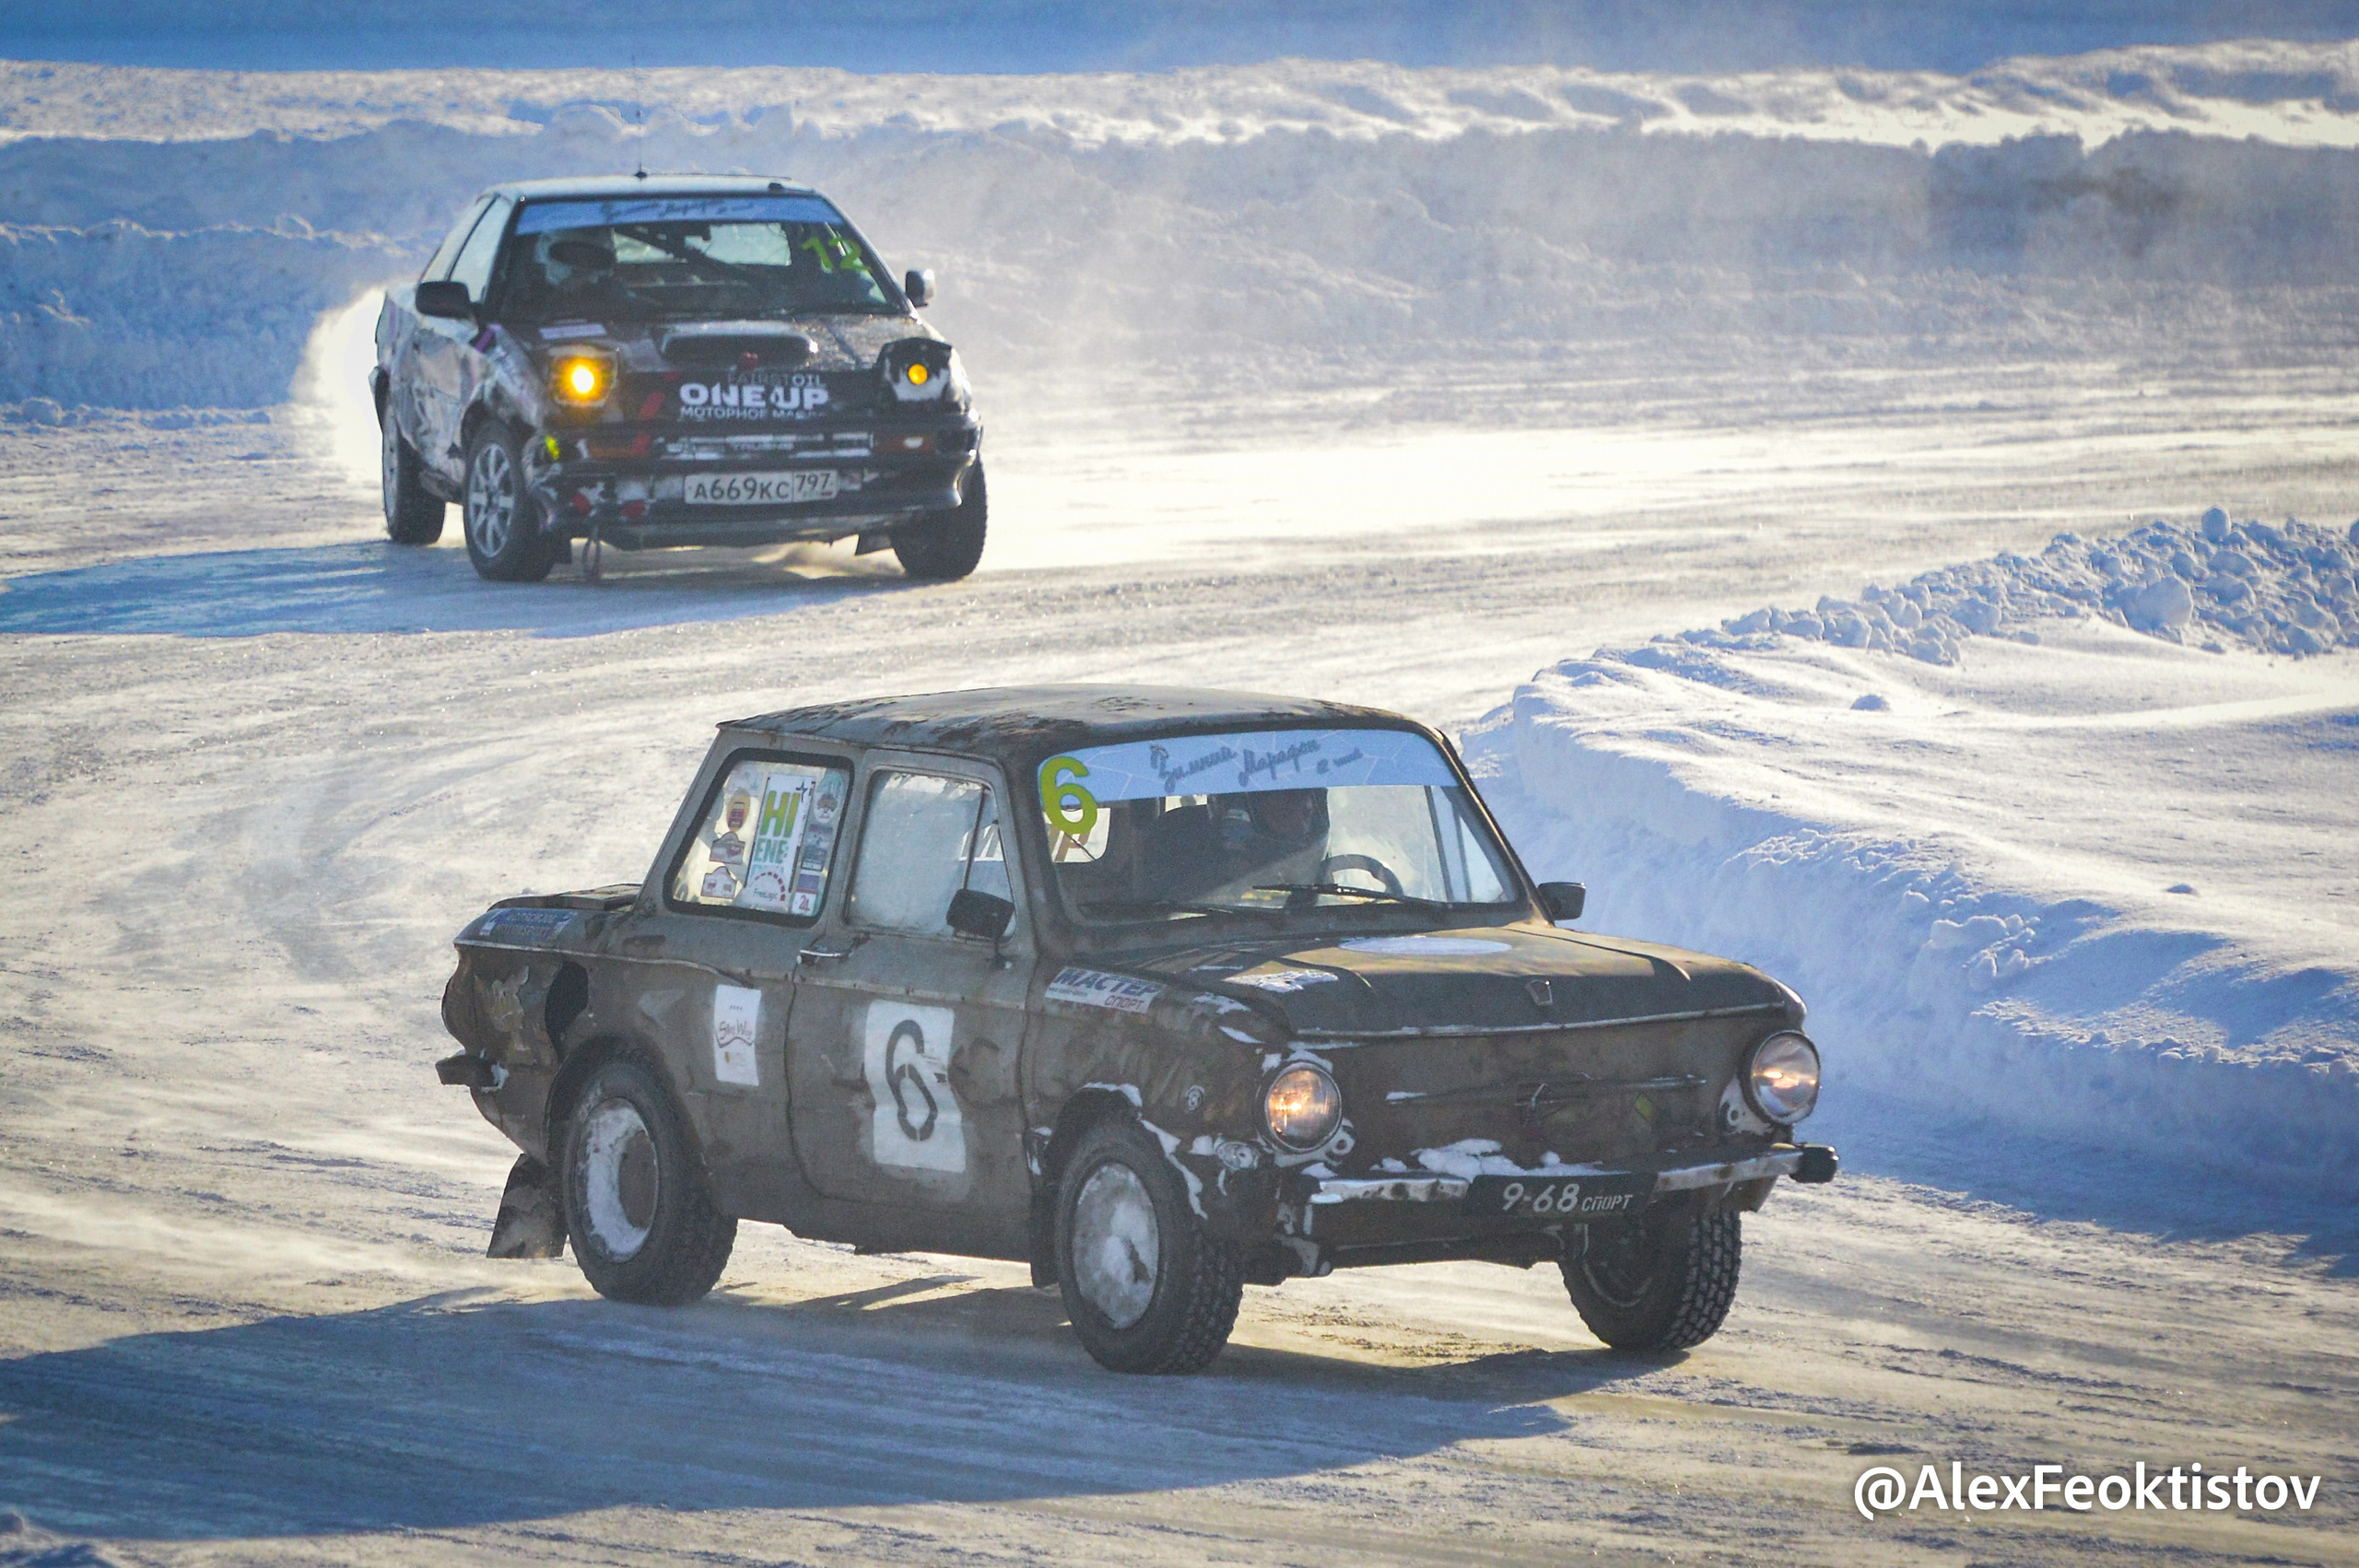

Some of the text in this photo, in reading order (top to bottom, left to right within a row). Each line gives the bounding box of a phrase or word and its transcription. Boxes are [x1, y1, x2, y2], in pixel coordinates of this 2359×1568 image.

[680, 381, 829, 410] ONE UP
[694, 473, 831, 500] А669КС 797
[1039, 755, 1098, 836] 6
[760, 790, 801, 837] HI
[1052, 968, 1162, 997] МАСТЕР
[1104, 995, 1145, 1011] СПОРТ
[886, 1019, 938, 1141] 6
[1502, 1182, 1580, 1212] 9-68
